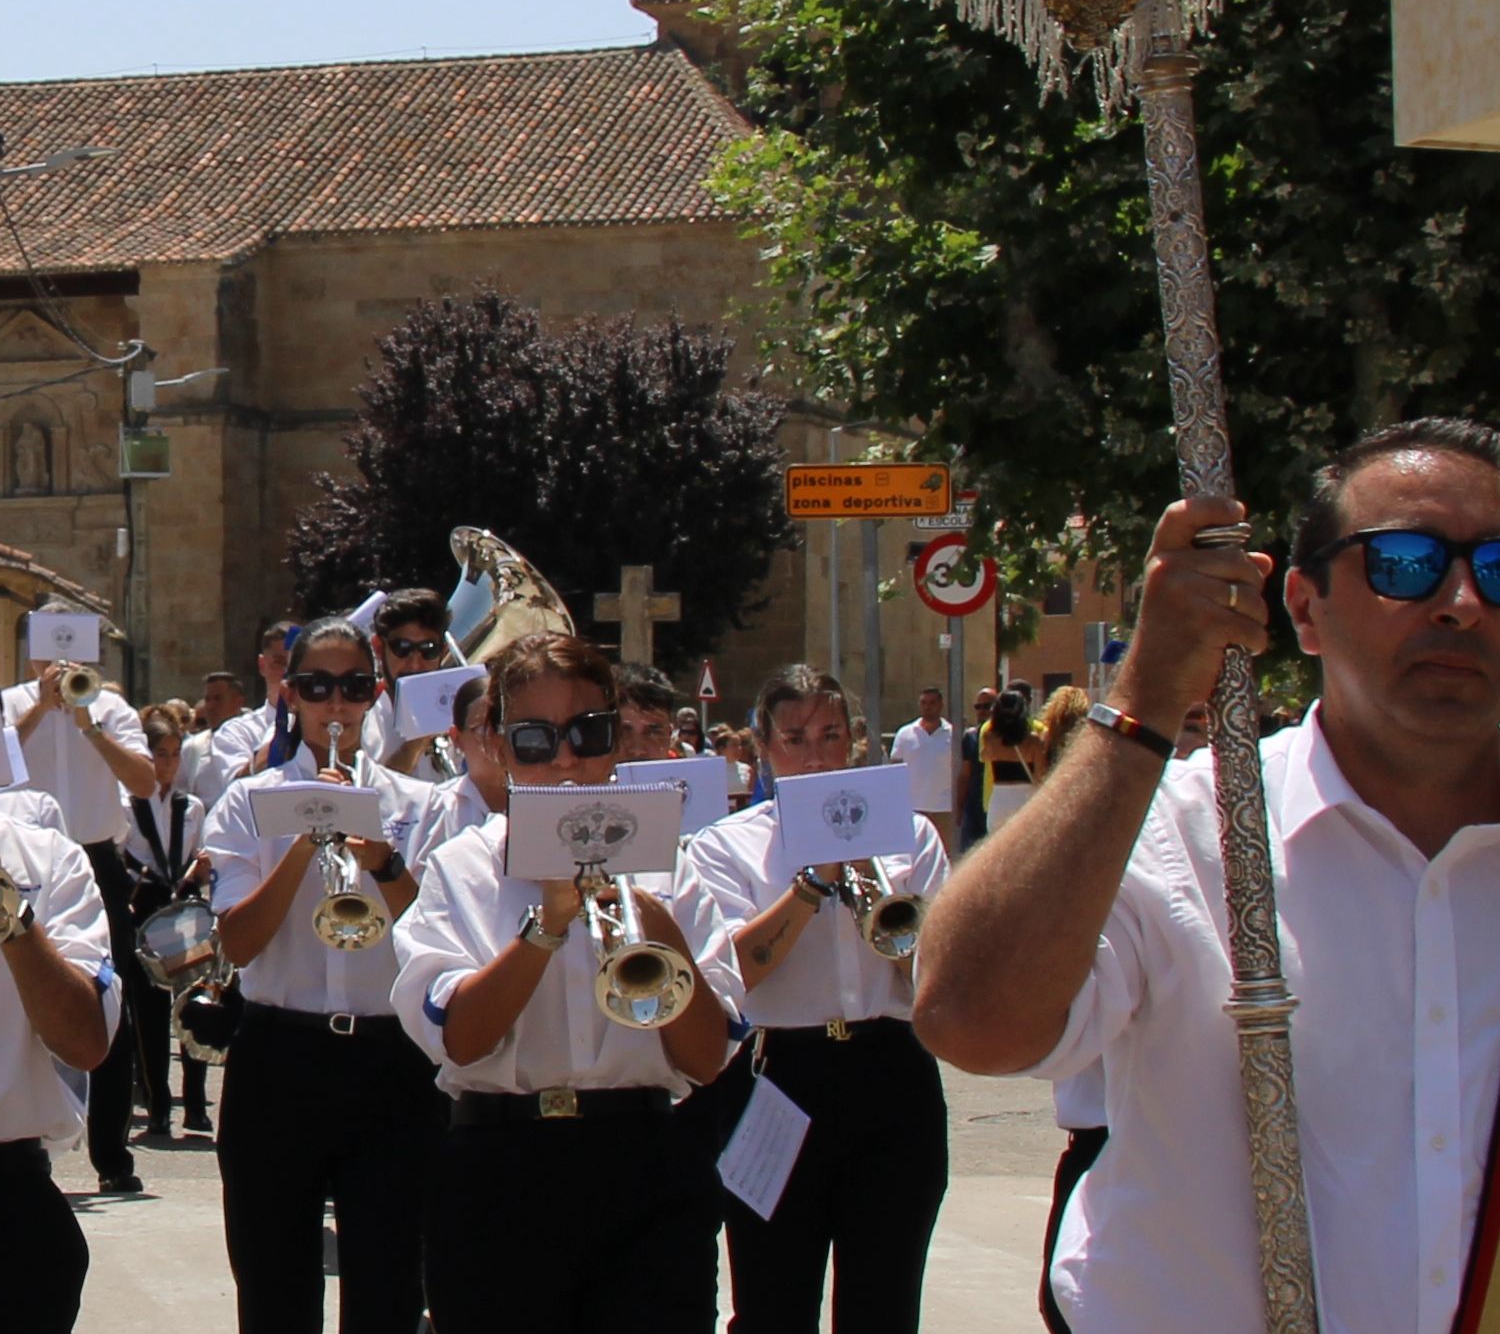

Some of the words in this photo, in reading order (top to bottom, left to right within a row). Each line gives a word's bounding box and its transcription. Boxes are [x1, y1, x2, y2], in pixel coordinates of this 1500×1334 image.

[792, 474, 863, 489] piscinas
[793, 499, 831, 509] zona
[843, 495, 922, 511] deportiva
